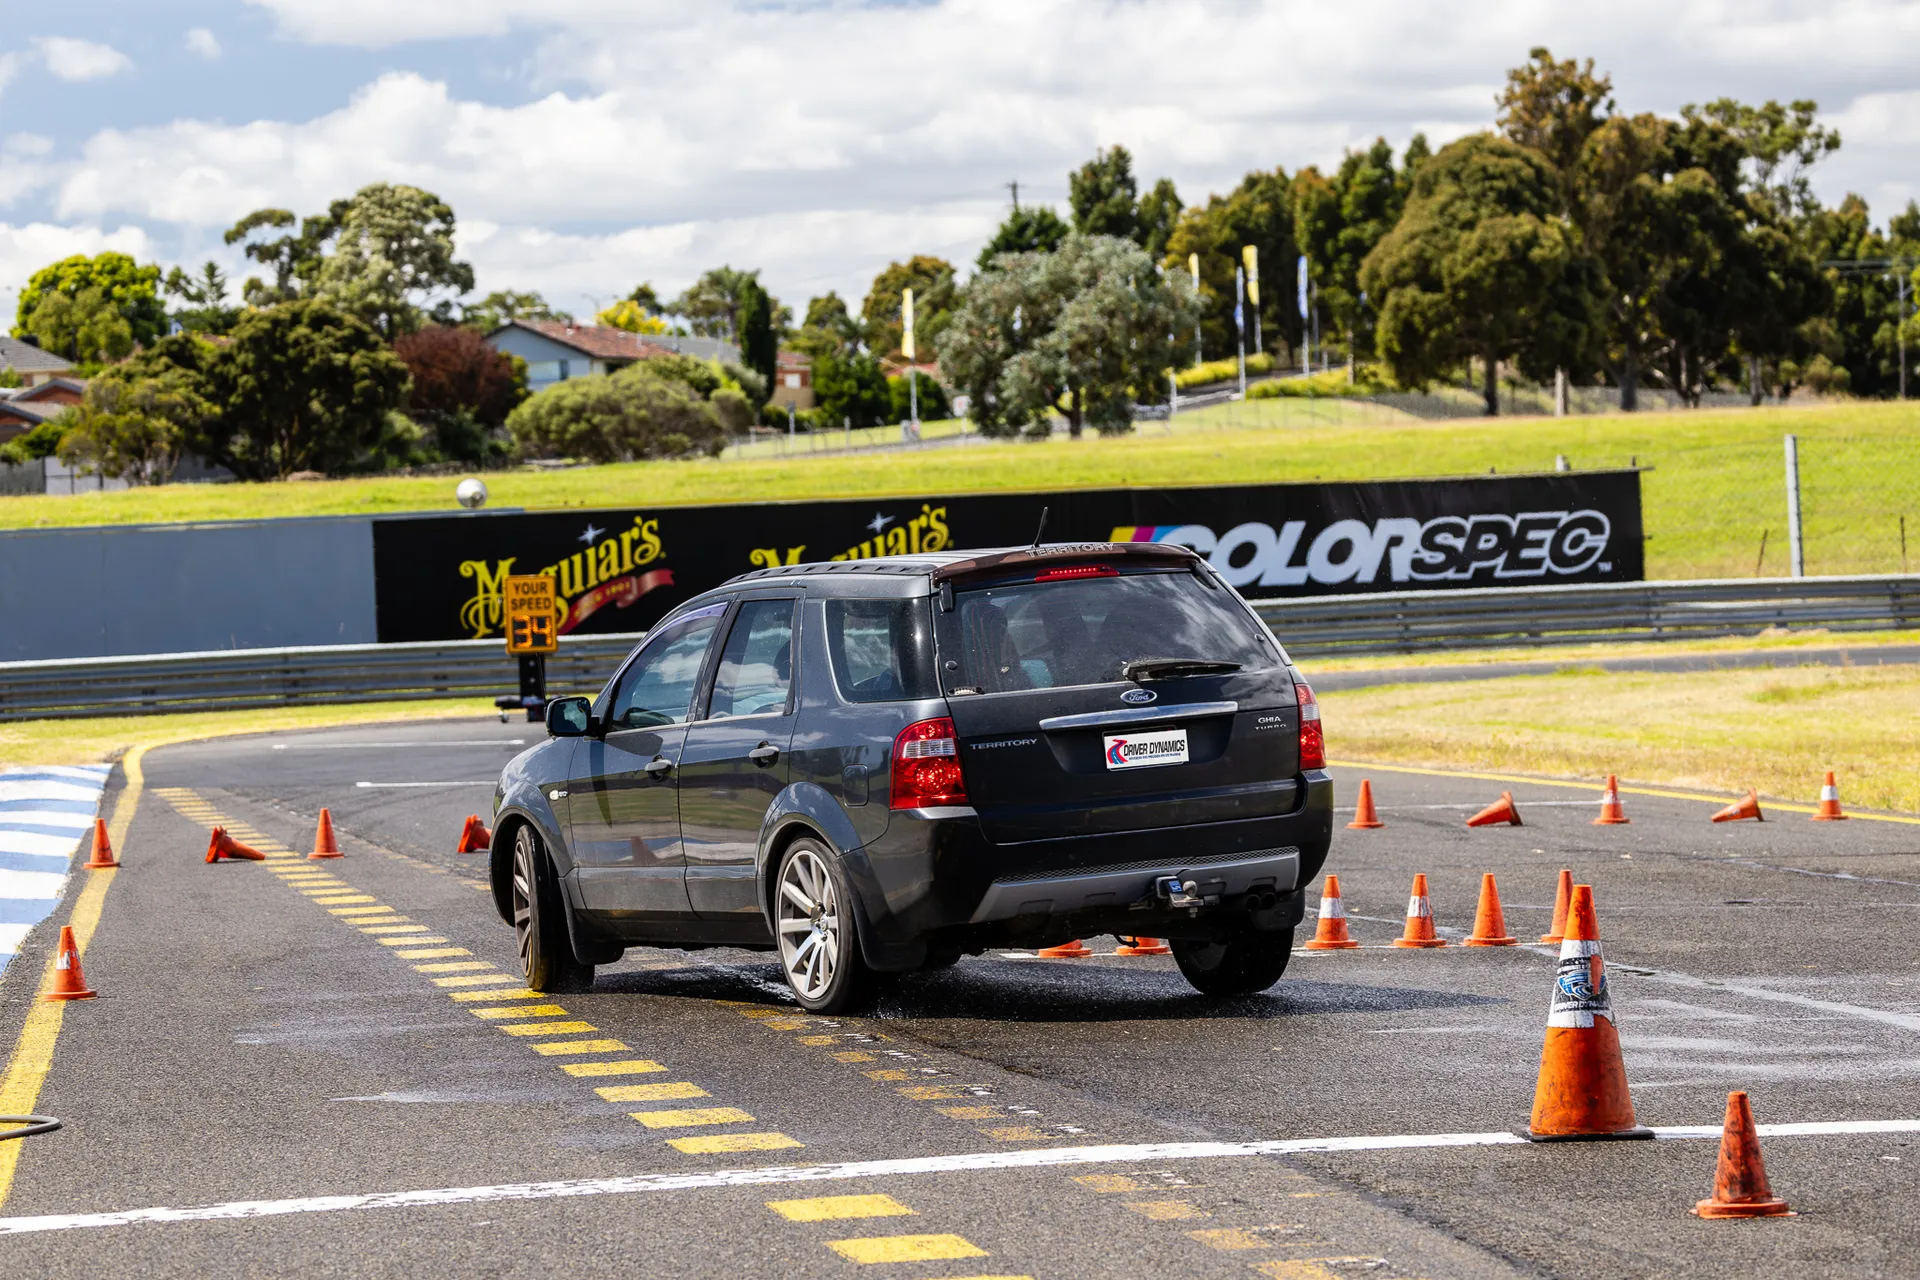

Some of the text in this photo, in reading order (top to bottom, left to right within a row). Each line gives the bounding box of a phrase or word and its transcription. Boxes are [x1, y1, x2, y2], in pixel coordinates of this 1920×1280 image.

[1025, 543, 1114, 558] TERRITORY
[459, 515, 662, 639] Muiar's
[513, 581, 548, 595] YOUR
[511, 597, 553, 611] SPEED
[513, 615, 552, 649] 34
[1257, 715, 1282, 724] GHIA
[969, 738, 1038, 750] TERRITORY
[1123, 742, 1148, 757] DRIVER
[1149, 739, 1185, 754] DYNAMICS
